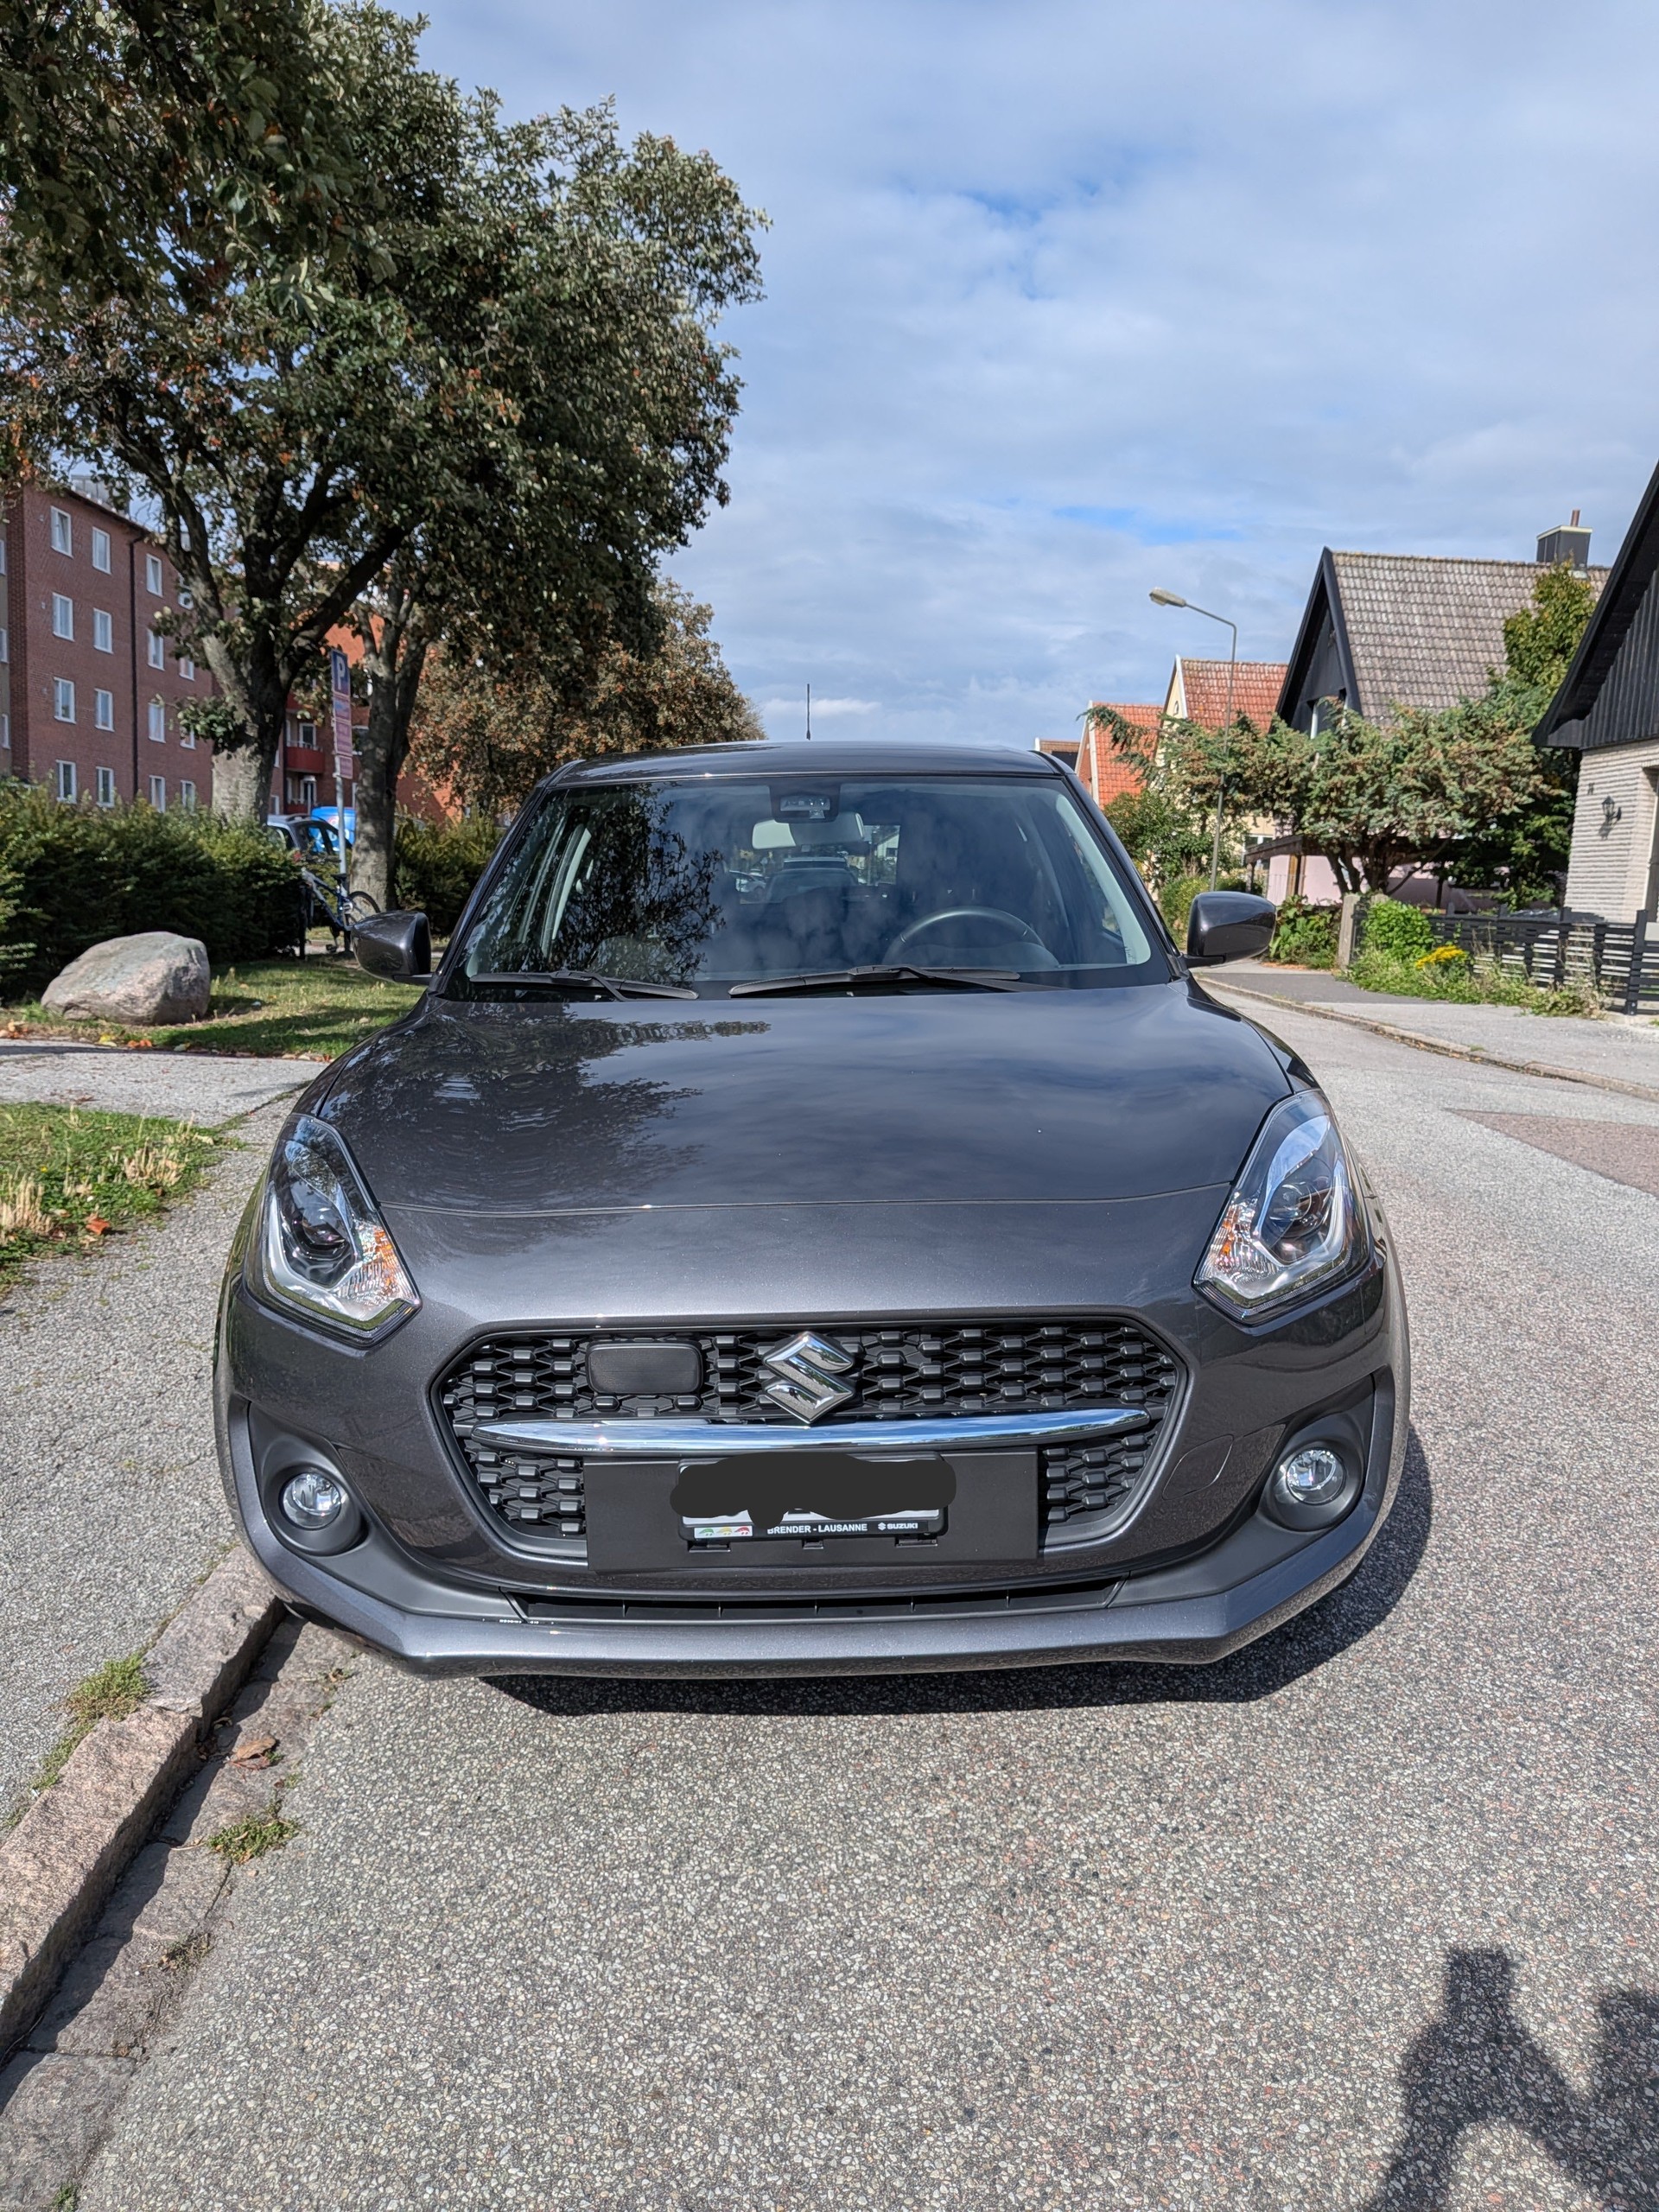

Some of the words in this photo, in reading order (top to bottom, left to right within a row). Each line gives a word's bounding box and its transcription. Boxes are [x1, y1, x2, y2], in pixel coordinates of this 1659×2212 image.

[335, 654, 346, 690] P
[766, 1525, 812, 1535] BRENDER
[817, 1523, 868, 1533] LAUSANNE
